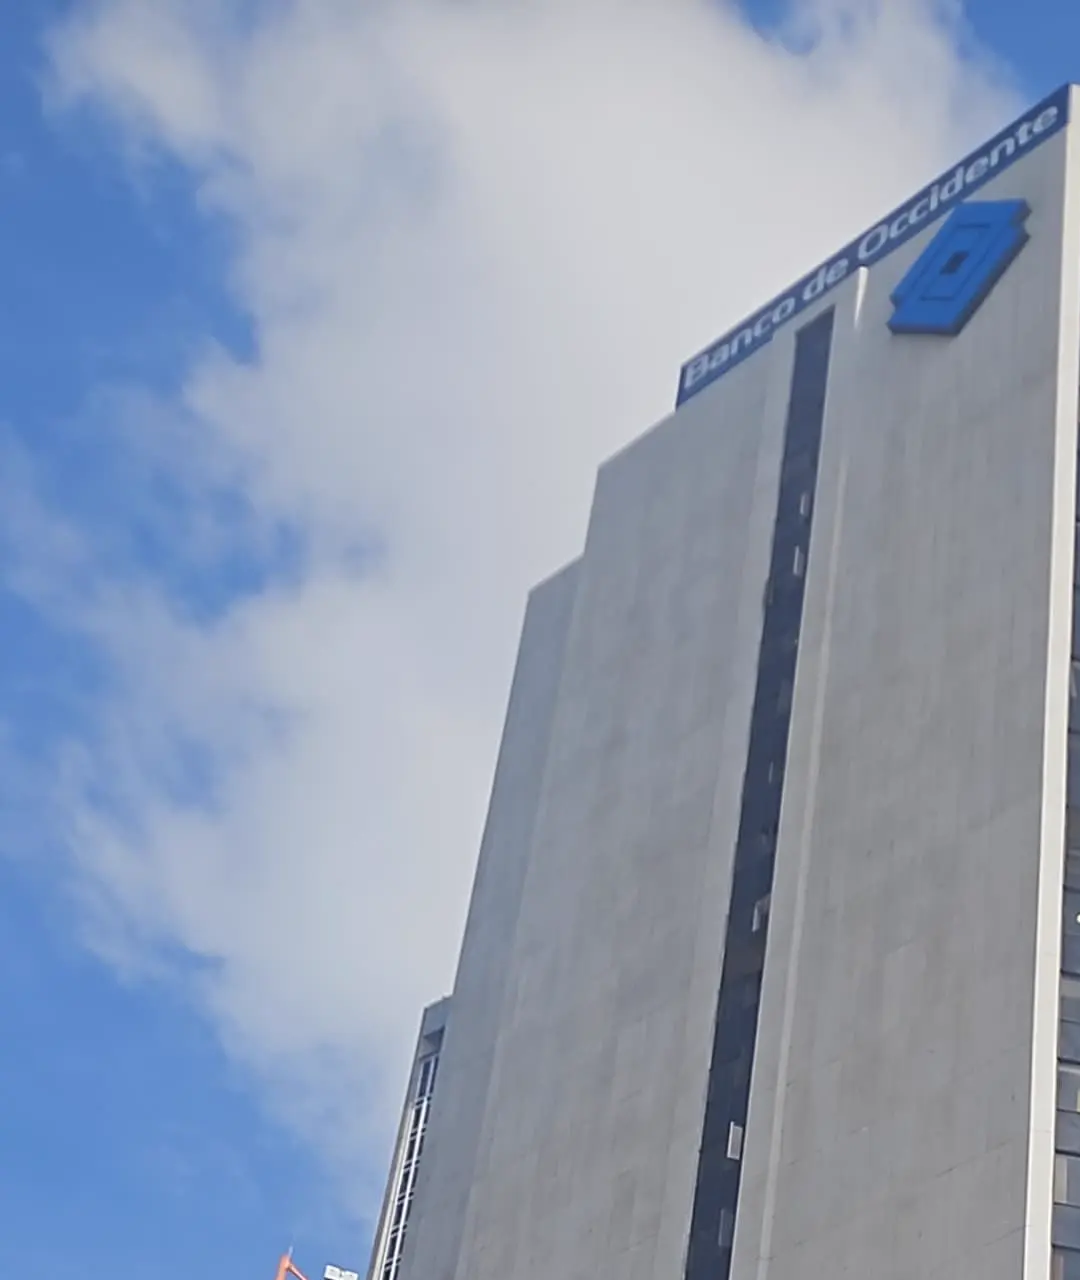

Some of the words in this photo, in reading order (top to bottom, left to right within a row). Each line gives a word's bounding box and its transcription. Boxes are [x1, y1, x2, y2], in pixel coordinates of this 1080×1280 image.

[684, 297, 796, 388] Banco
[802, 258, 849, 301] de
[858, 106, 1059, 260] Occidente
